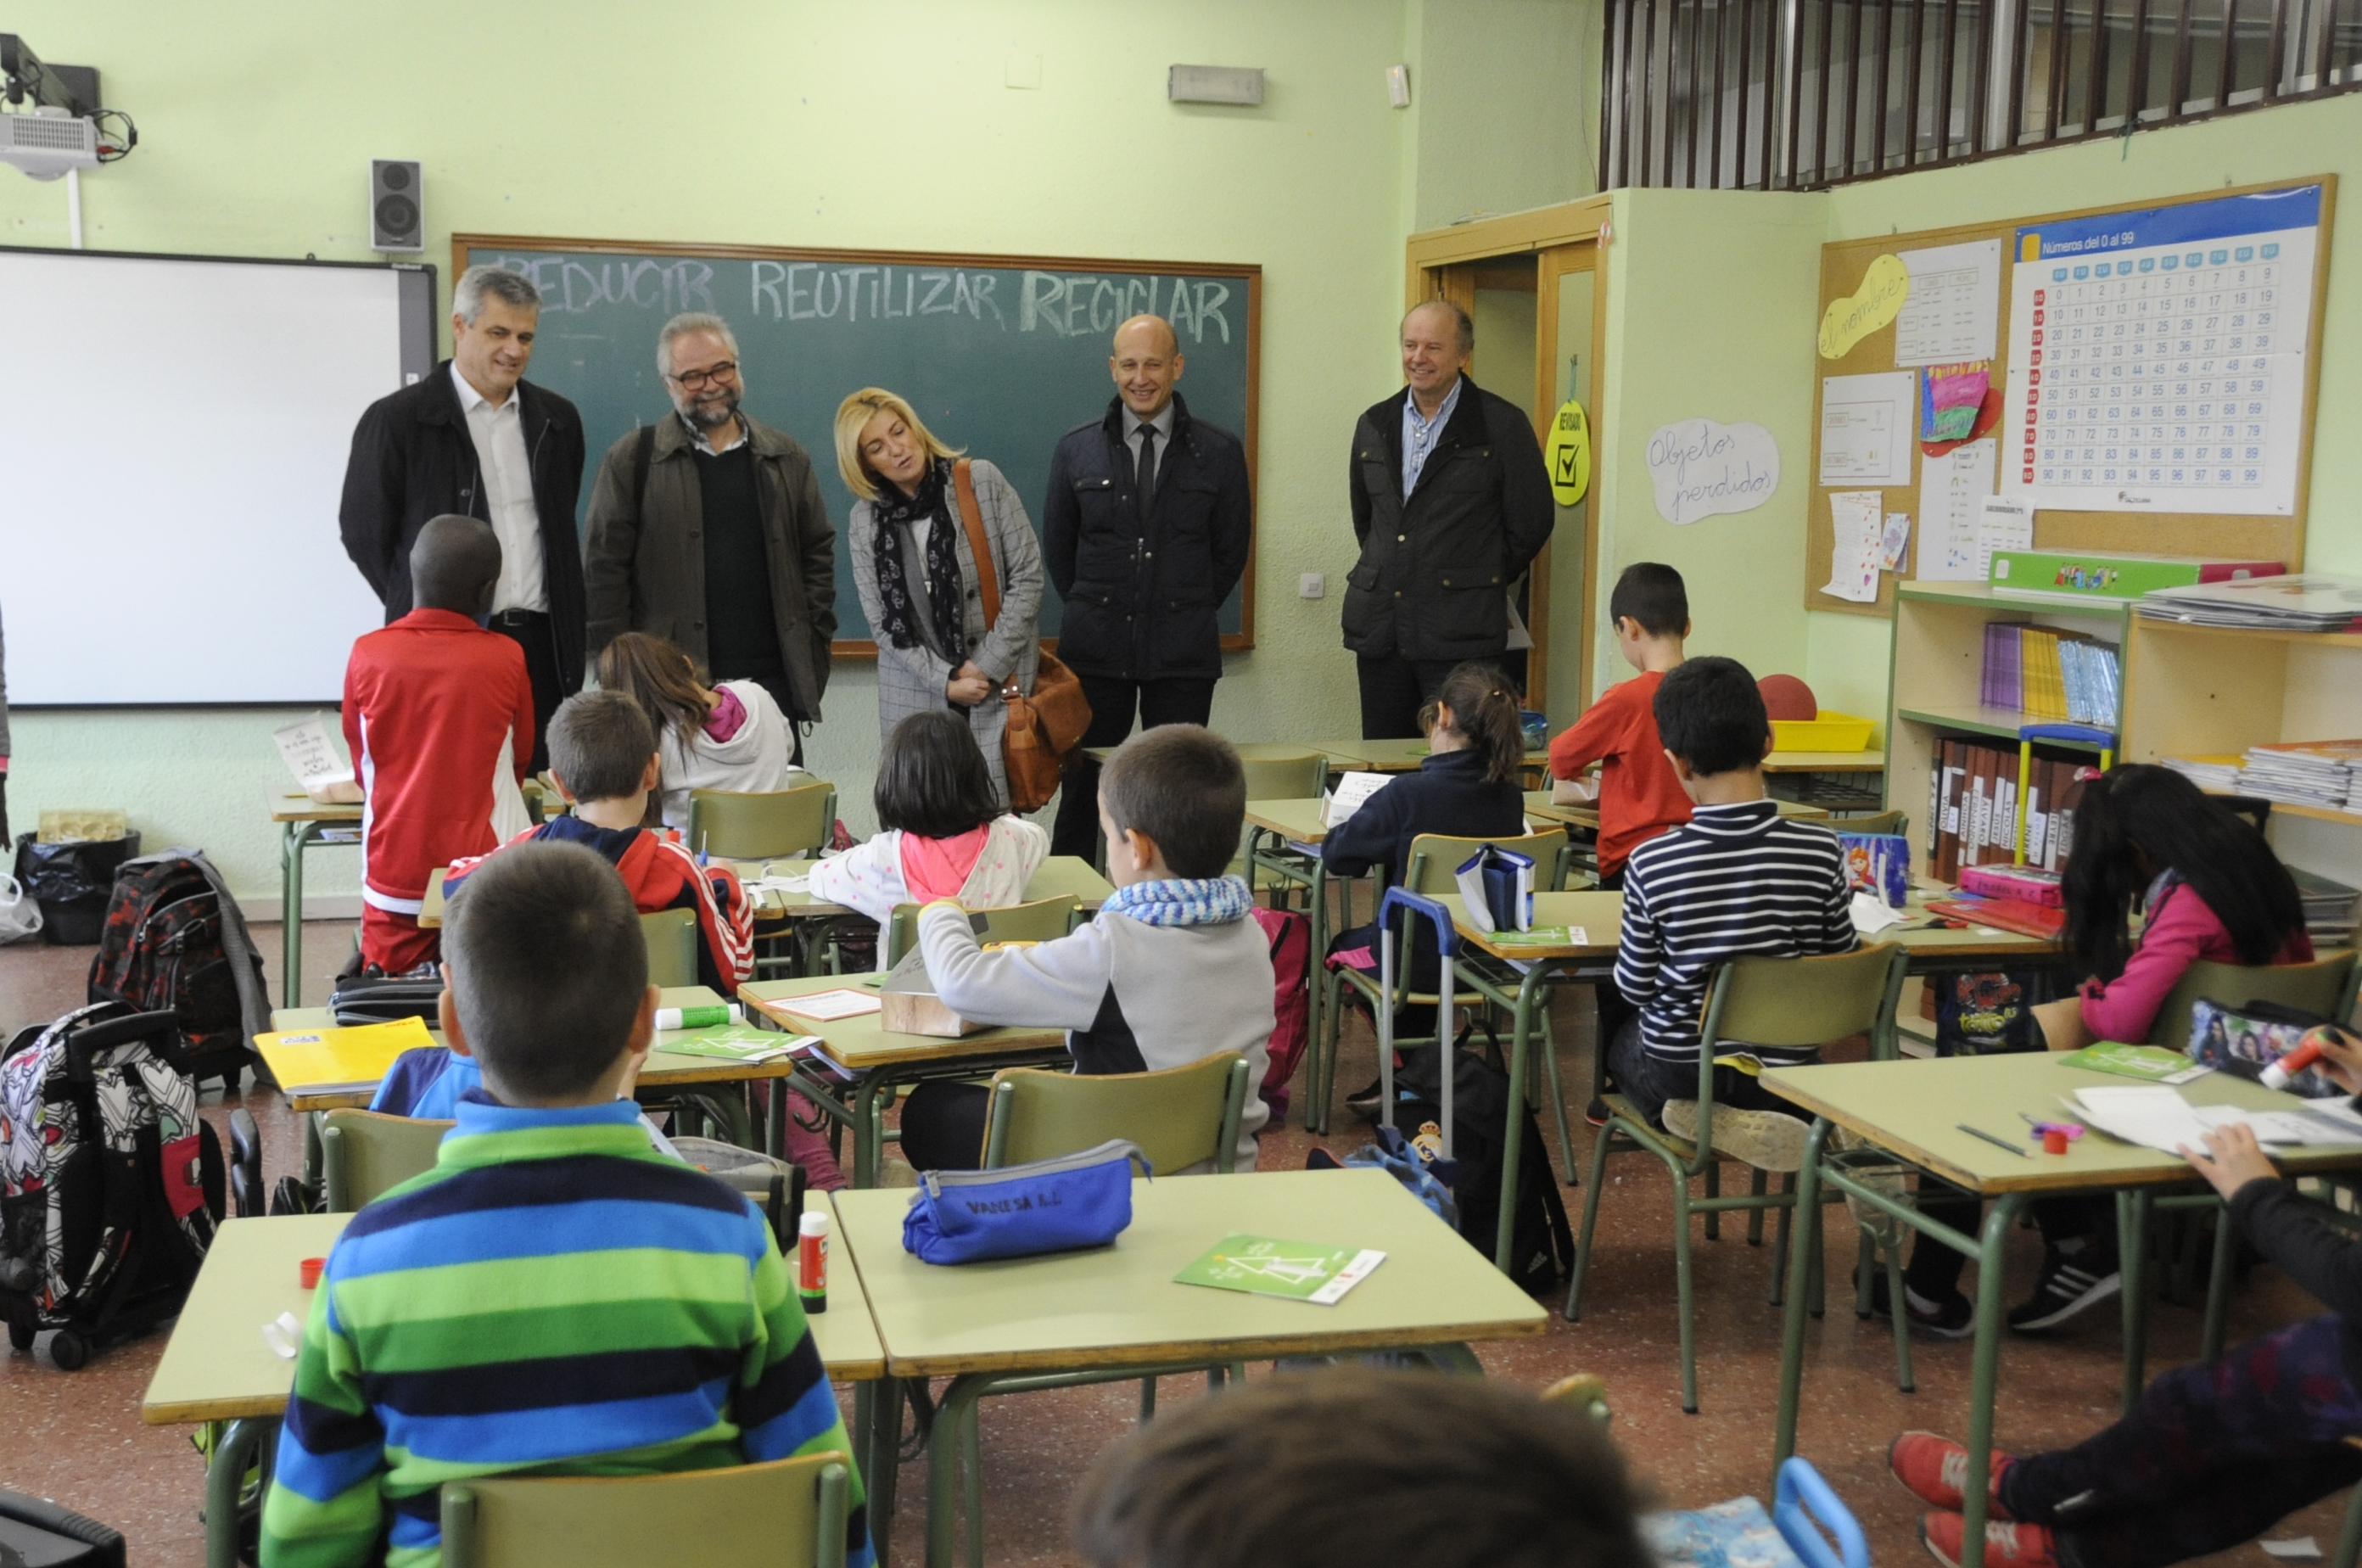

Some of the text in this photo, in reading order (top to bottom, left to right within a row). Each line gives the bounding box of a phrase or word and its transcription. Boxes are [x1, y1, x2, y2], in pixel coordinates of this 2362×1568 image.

[2042, 231, 2135, 254] Números del 0 al 99
[751, 260, 1006, 332] REUTILIZAR
[2056, 288, 2062, 300] 0
[2077, 287, 2081, 297] 1
[2098, 284, 2104, 295] 2
[2120, 282, 2125, 294] 3
[2141, 280, 2147, 290] 4
[2163, 277, 2170, 288] 5
[2188, 275, 2195, 286] 6
[2214, 272, 2219, 283] 7
[2238, 270, 2245, 282] 8
[2264, 267, 2270, 279] 9
[1841, 277, 1903, 334] nombre
[2053, 309, 2063, 320] 10
[2074, 307, 2083, 318] 11
[2095, 305, 2105, 316] 12
[2116, 303, 2126, 314] 13
[2137, 301, 2147, 312] 14
[2159, 299, 2171, 311] 15
[2184, 296, 2196, 308] 16
[2209, 294, 2221, 305] 17
[2234, 292, 2246, 304] 18
[2260, 289, 2272, 301] 19
[2051, 329, 2063, 340] 20
[2072, 328, 2081, 339] 21
[2093, 326, 2104, 338] 22
[2113, 324, 2124, 335] 23
[2134, 322, 2145, 333] 24
[2157, 320, 2169, 332] 25
[2180, 318, 2192, 330] 26
[2205, 316, 2219, 328] 27
[2231, 314, 2243, 327] 28
[2258, 312, 2270, 324] 29
[2050, 349, 2061, 360] 30
[2070, 348, 2079, 359] 31
[2091, 346, 2102, 357] 32
[2112, 344, 2122, 356] 33
[2133, 344, 2143, 355] 34
[2156, 342, 2167, 353] 35
[2179, 340, 2191, 352] 36
[2203, 339, 2216, 350] 37
[2229, 337, 2242, 349] 38
[2255, 335, 2269, 347] 39
[2049, 369, 2059, 379] 40
[2069, 368, 2079, 378] 41
[2090, 367, 2101, 378] 42
[2111, 365, 2122, 377] 43
[2132, 365, 2142, 374] 44
[2152, 363, 2165, 374] 45
[2176, 361, 2189, 373] 46
[2201, 361, 2214, 372] 47
[2225, 359, 2239, 370] 48
[2252, 357, 2265, 369] 49
[2047, 389, 2057, 400] 50
[2068, 388, 2078, 399] 51
[2089, 387, 2100, 398] 52
[2110, 386, 2121, 397] 53
[2131, 385, 2142, 396] 54
[2152, 384, 2163, 395] 55
[2175, 383, 2187, 395] 56
[2199, 382, 2211, 394] 57
[2224, 381, 2236, 393] 58
[2250, 379, 2264, 392] 59
[2046, 409, 2057, 419] 60
[2067, 408, 2076, 419] 61
[2087, 407, 2097, 418] 62
[2108, 406, 2119, 417] 63
[2130, 406, 2140, 417] 64
[2152, 406, 2163, 417] 65
[2174, 405, 2186, 416] 66
[2198, 404, 2211, 415] 67
[2223, 403, 2236, 415] 68
[2248, 402, 2261, 414] 69
[2046, 428, 2056, 440] 70
[2066, 428, 2075, 439] 71
[2085, 428, 2096, 439] 72
[2107, 428, 2119, 439] 73
[2130, 427, 2139, 438] 74
[2152, 427, 2163, 438] 75
[2174, 426, 2186, 437] 76
[2198, 425, 2209, 437] 77
[2222, 425, 2233, 437] 78
[2247, 424, 2259, 436] 79
[1650, 424, 1735, 484] Objetos
[2044, 449, 2054, 459] 80
[2064, 449, 2073, 459] 81
[2083, 448, 2094, 459] 82
[2105, 448, 2117, 459] 83
[2129, 448, 2138, 459] 84
[2150, 447, 2162, 459] 85
[2172, 447, 2184, 459] 86
[2196, 447, 2208, 459] 87
[2219, 447, 2232, 458] 88
[2245, 447, 2258, 458] 89
[2043, 468, 2053, 479] 90
[2063, 468, 2071, 479] 91
[2081, 468, 2092, 479] 92
[2104, 468, 2115, 479] 93
[2127, 468, 2137, 479] 94
[2149, 468, 2160, 480] 95
[2172, 469, 2182, 480] 96
[2195, 469, 2207, 480] 97
[2219, 469, 2230, 480] 98
[2244, 469, 2257, 480] 99
[1672, 461, 1771, 520] perdidos
[1969, 789, 1979, 849] FERNANDO
[2049, 816, 2057, 845] LEYRE
